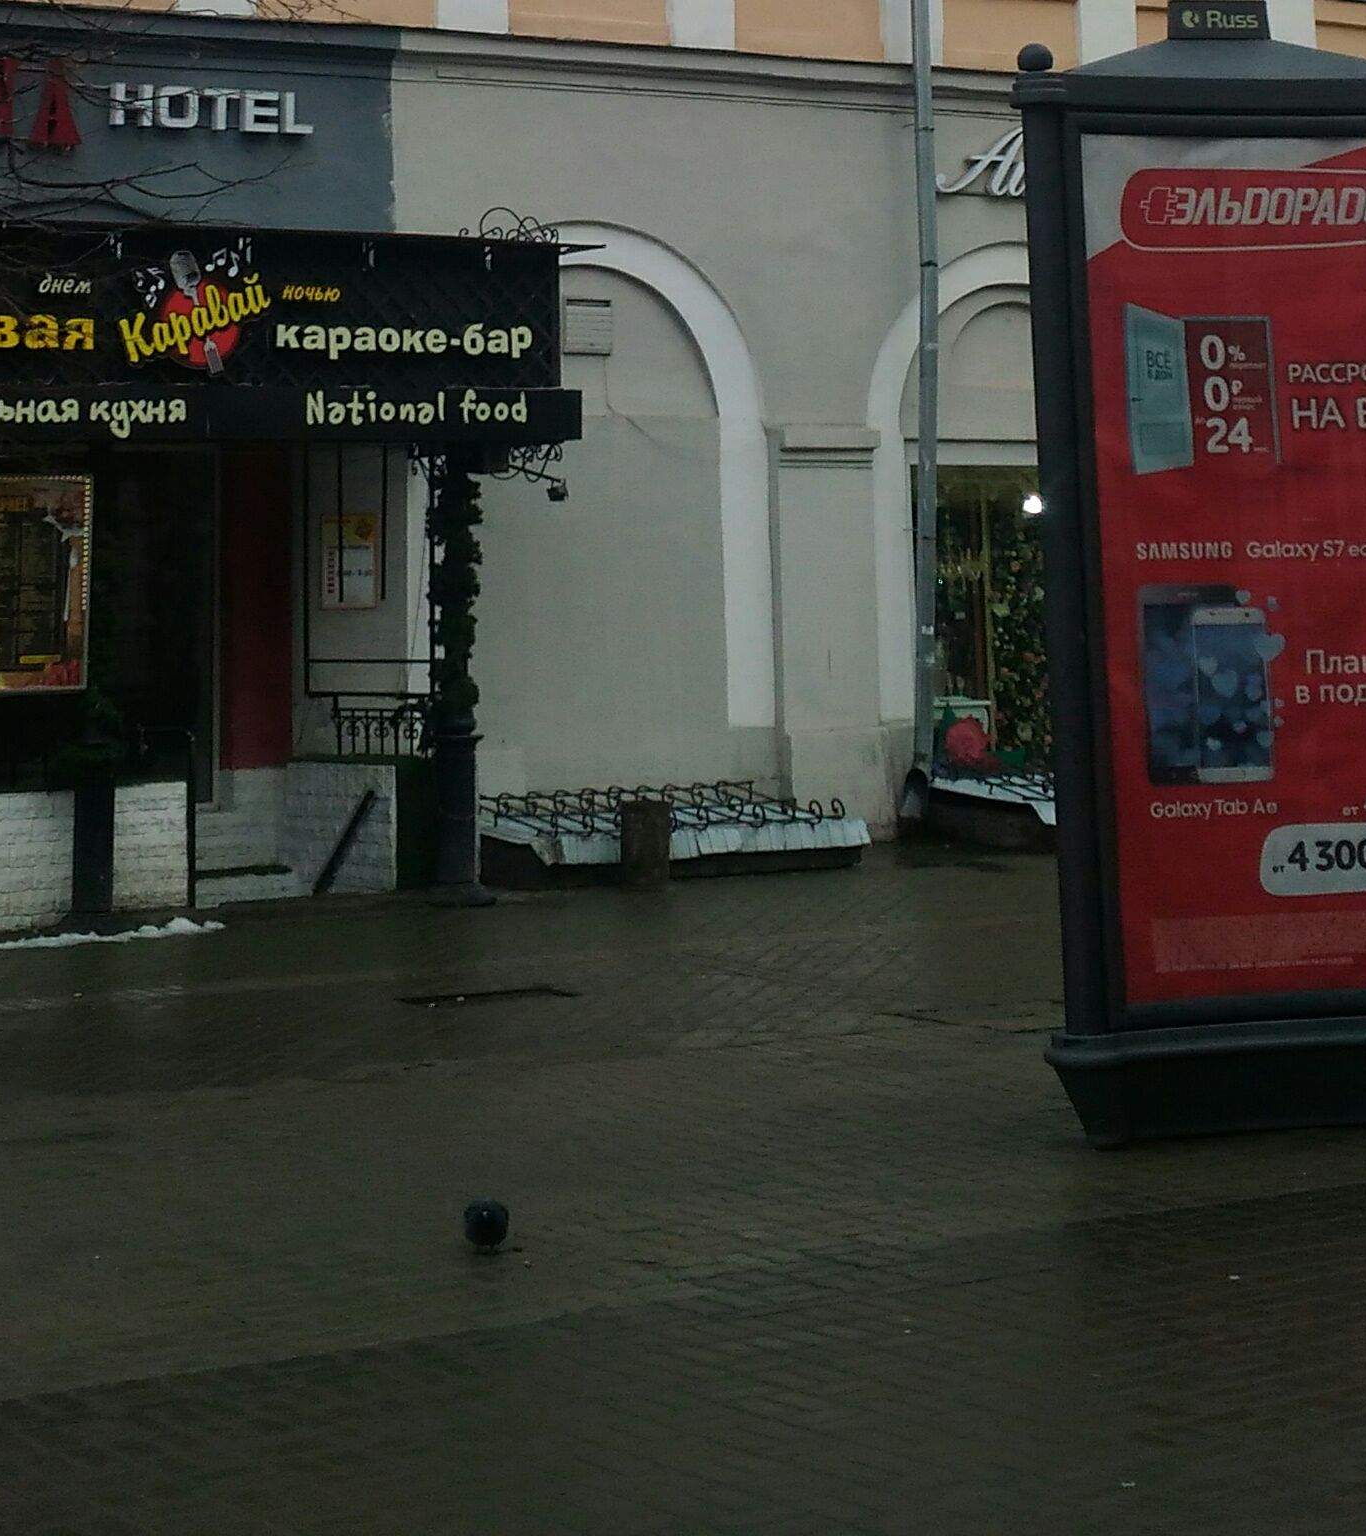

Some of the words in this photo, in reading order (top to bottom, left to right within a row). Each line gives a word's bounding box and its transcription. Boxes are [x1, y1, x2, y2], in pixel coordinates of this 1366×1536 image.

[1206, 9, 1260, 29] Russ
[110, 81, 314, 135] HOTEL
[281, 284, 341, 304] ночью
[119, 272, 272, 363] Каравай
[275, 323, 533, 360] караоке-бар
[90, 397, 187, 439] кухня
[459, 389, 528, 424] food
[1292, 398, 1344, 430] НА
[1206, 416, 1254, 454] 24
[1136, 541, 1233, 560] SAMSUNG
[1246, 540, 1319, 562] Galaxy
[1323, 539, 1346, 557] S7
[1295, 685, 1310, 704] в
[1150, 801, 1213, 821] Galaxy
[1213, 798, 1248, 816] Tab
[1342, 805, 1360, 817] от
